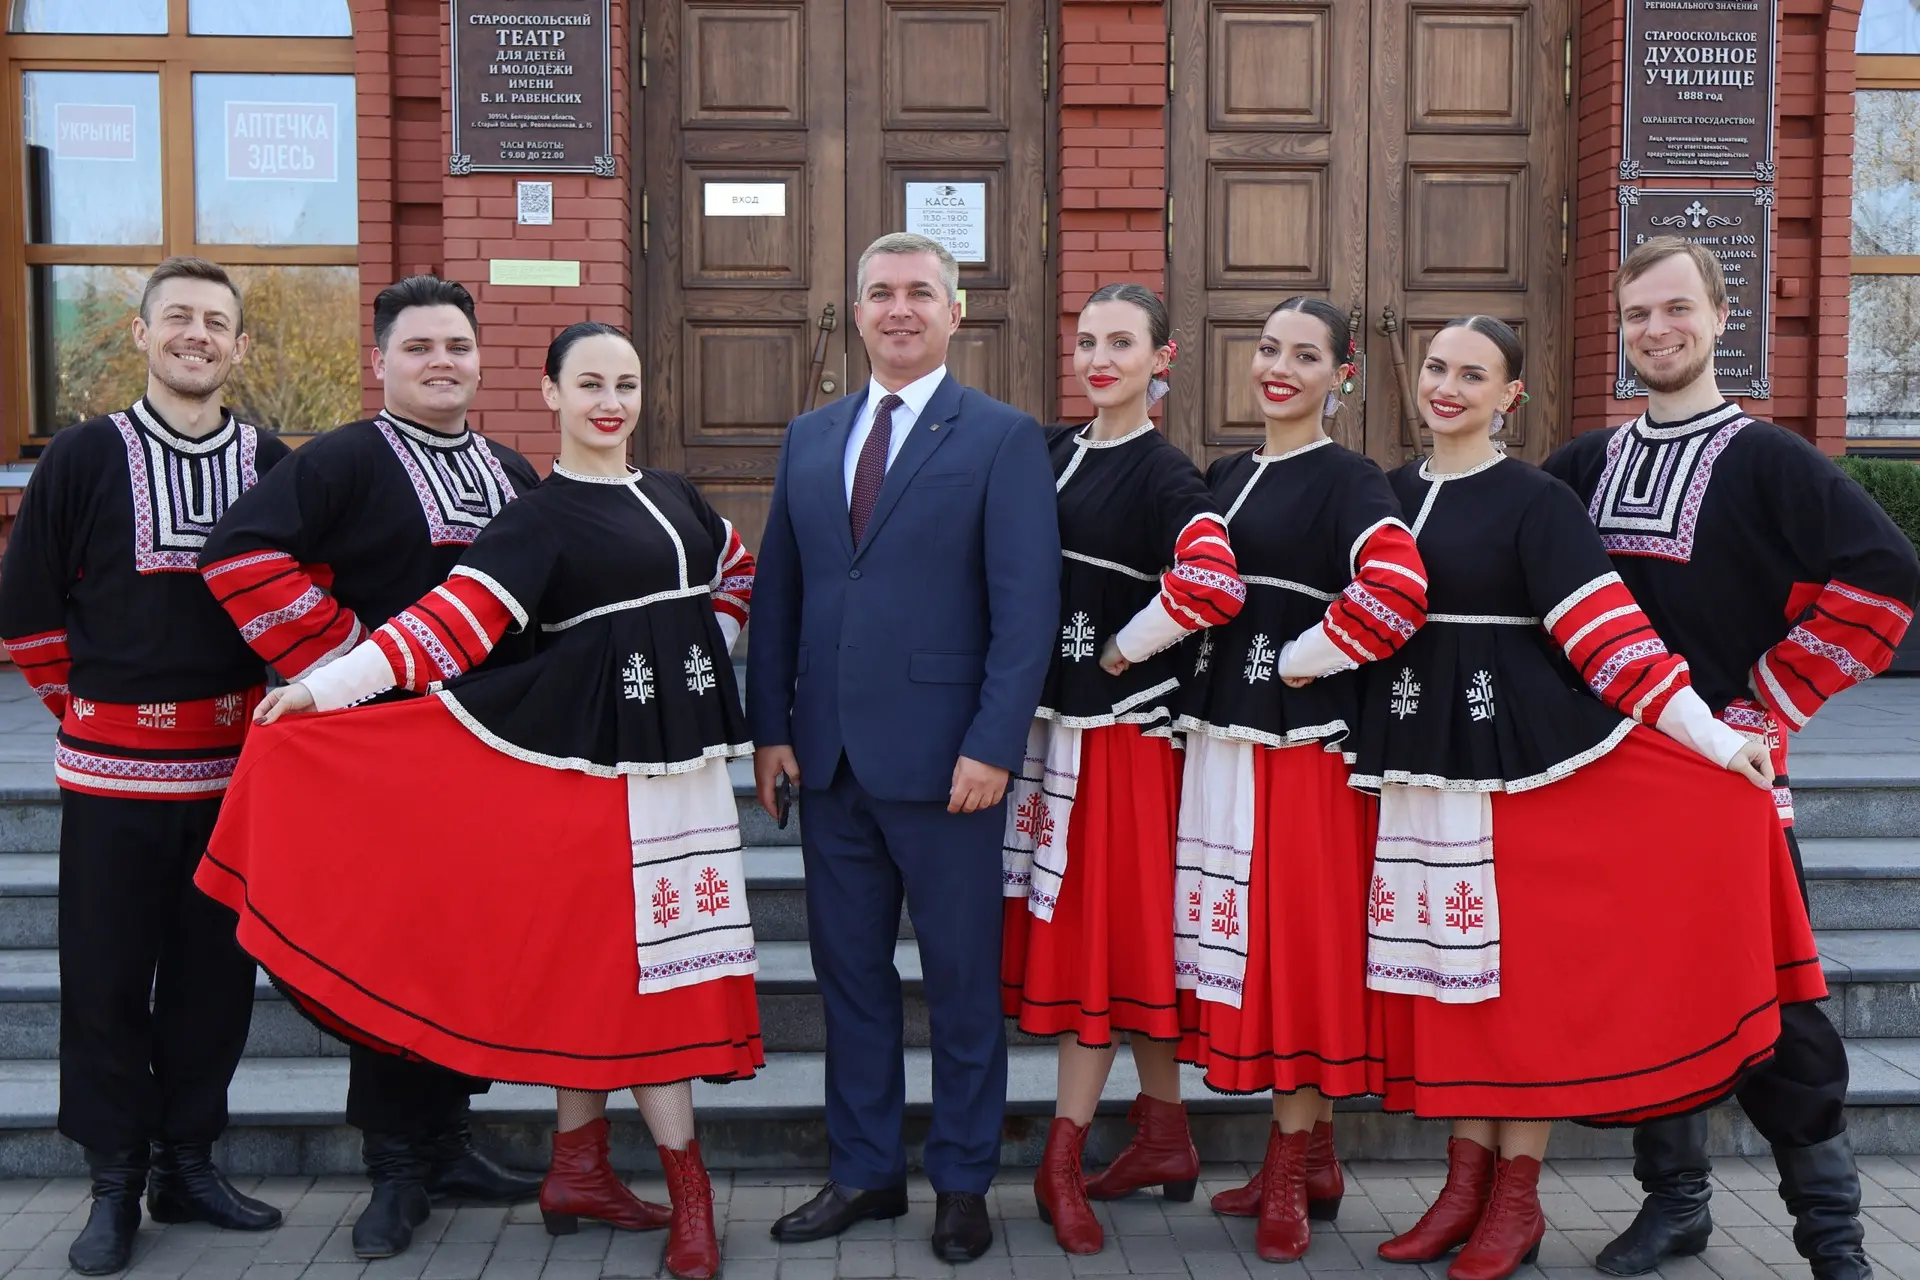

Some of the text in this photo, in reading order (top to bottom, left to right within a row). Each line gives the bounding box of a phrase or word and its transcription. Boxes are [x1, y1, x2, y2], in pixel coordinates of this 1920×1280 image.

[470, 13, 591, 25] СТАРООСКОЛЬСКИЙ
[496, 30, 565, 46] ТЕАТР
[1645, 31, 1757, 42] СТАРООСКОЛЬСКОЕ
[496, 49, 565, 61] ДЛЯ ДЕТЕЙ
[1644, 46, 1757, 65] ДУХОВНОЕ
[489, 63, 573, 76] И МОЛОДЁЖИ
[509, 79, 554, 89] ИМЕНИ
[1646, 69, 1755, 89] УЧИЛИЩЕ
[481, 93, 582, 104] Б. И. РАВЕНСКИХ
[1678, 91, 1723, 101] 1888 год
[234, 113, 329, 139] АПТЕЧКА
[1643, 116, 1755, 125] ОХРАНЯЕТСЯ ГОСУДАРСТВОМ
[60, 121, 131, 142] УКРЫТИЕ
[248, 145, 315, 174] ЗДЕСЬ
[527, 152, 539, 160] ДО
[732, 196, 759, 204] ВХОД
[925, 198, 965, 206] КАССА
[1636, 233, 1644, 244] В
[1722, 236, 1727, 244] с
[1731, 235, 1755, 244] 1900
